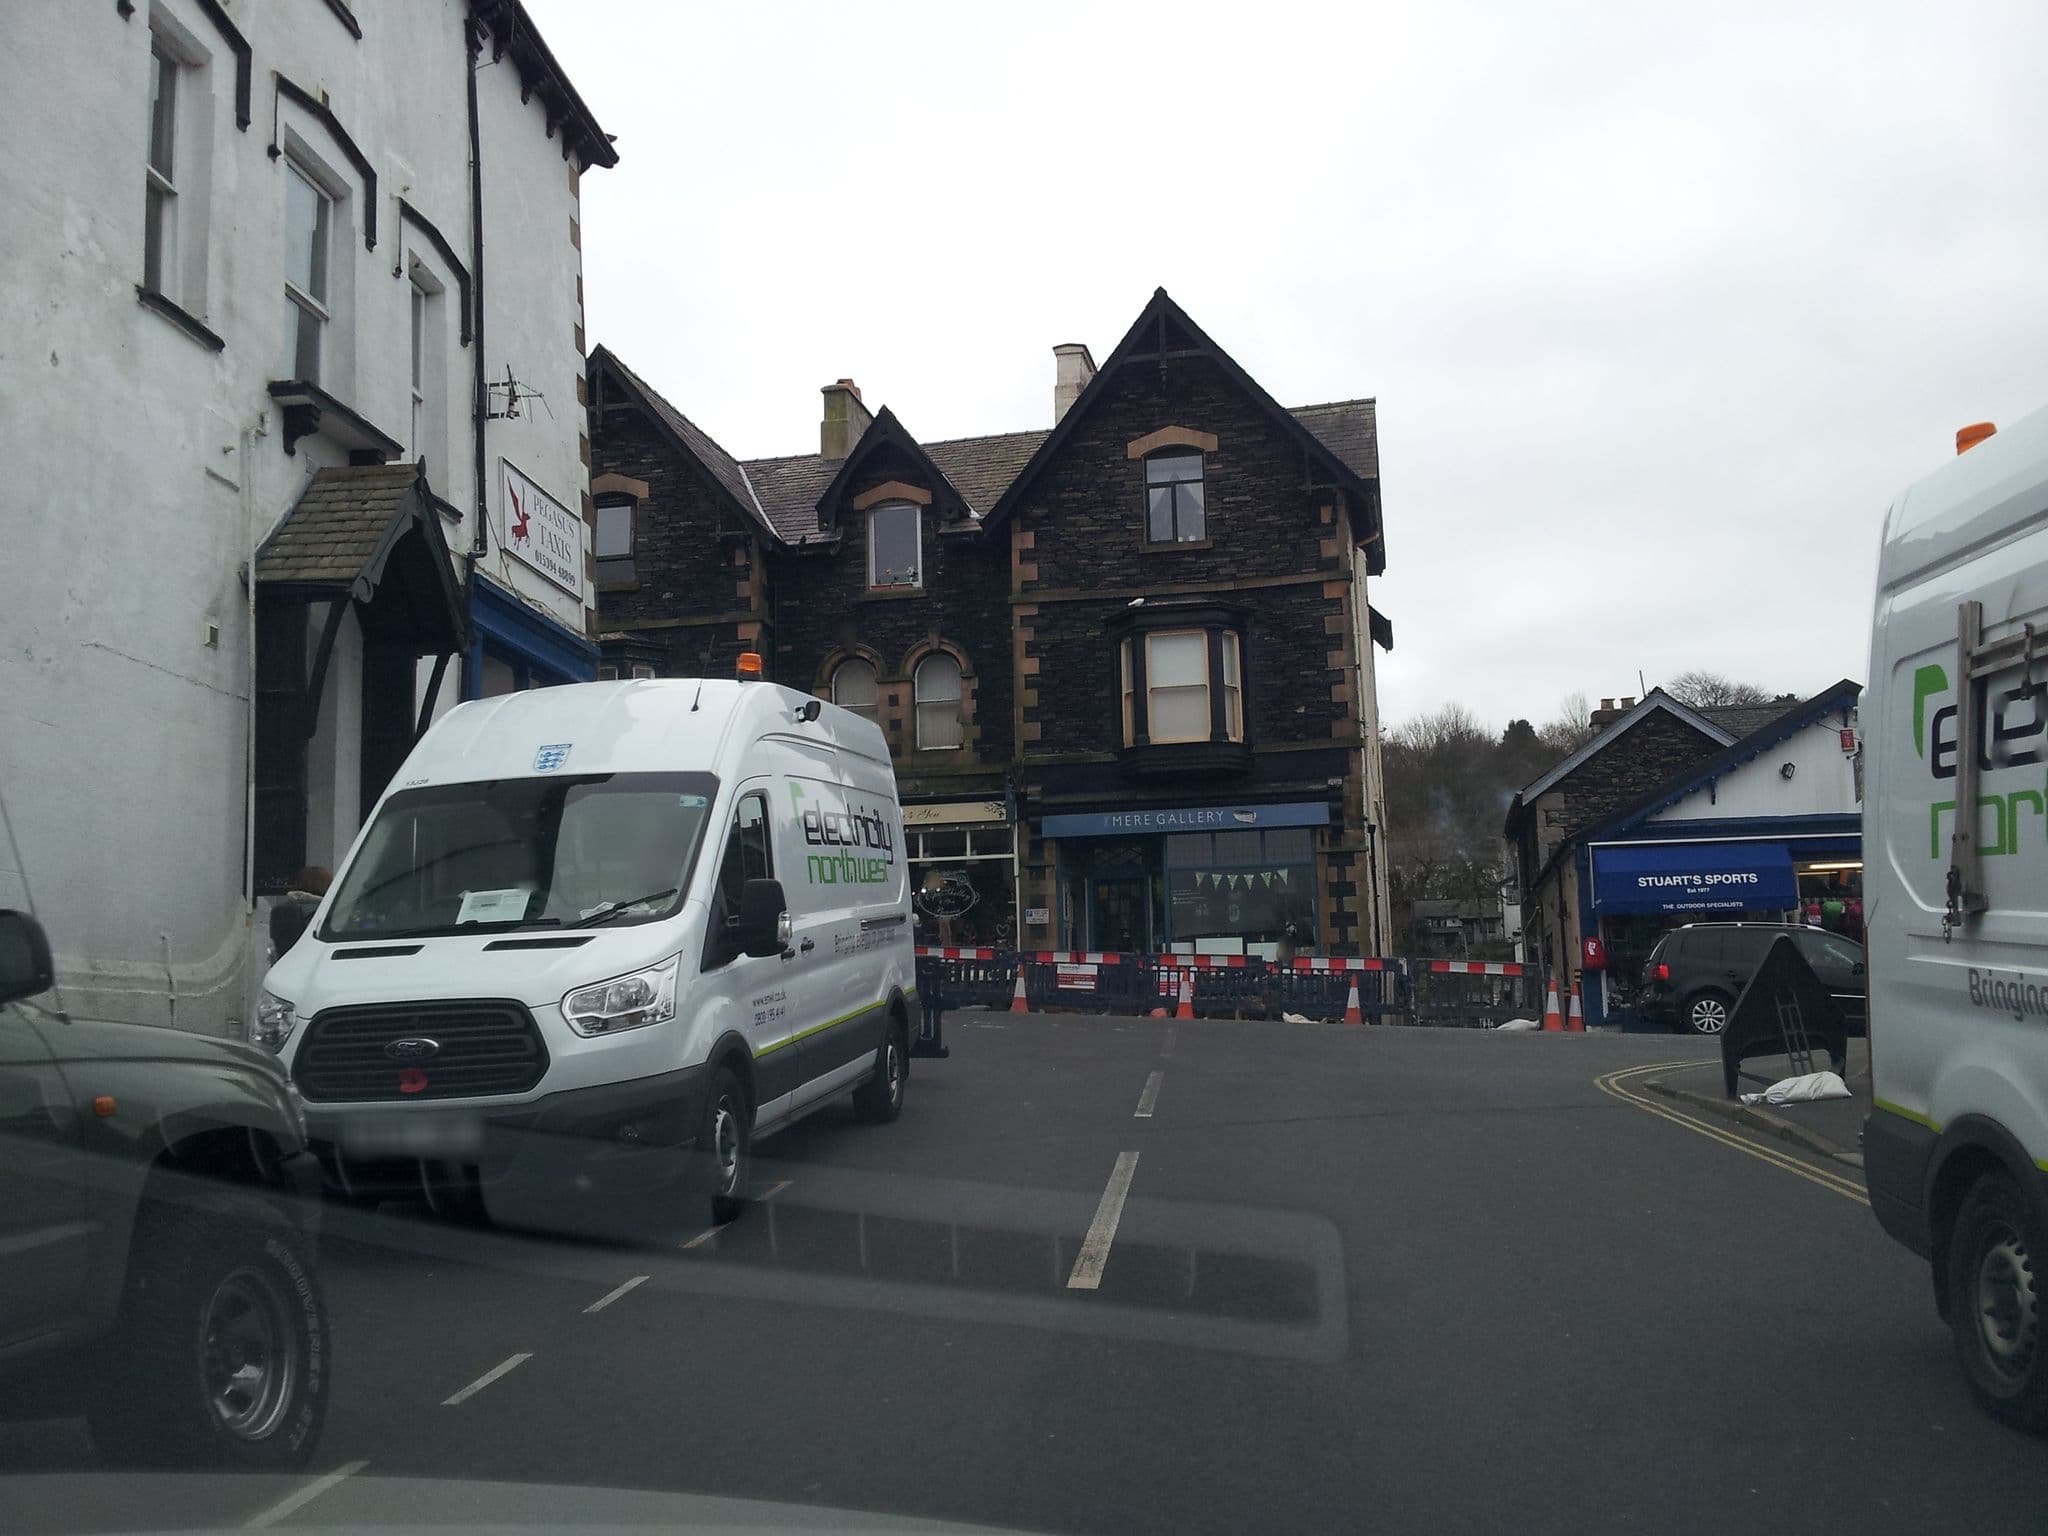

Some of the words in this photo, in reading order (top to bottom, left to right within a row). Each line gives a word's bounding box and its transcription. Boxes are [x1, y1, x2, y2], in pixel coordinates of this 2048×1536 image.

[534, 494, 575, 538] PEGASUS
[538, 522, 572, 563] TAXIS
[803, 800, 894, 865] electricity
[1112, 815, 1150, 827] MERE
[1156, 811, 1224, 825] GALLERY
[1638, 875, 1702, 887] STUART'S
[1704, 873, 1759, 885] SPORTS
[1706, 901, 1744, 909] SPECIALISTS
